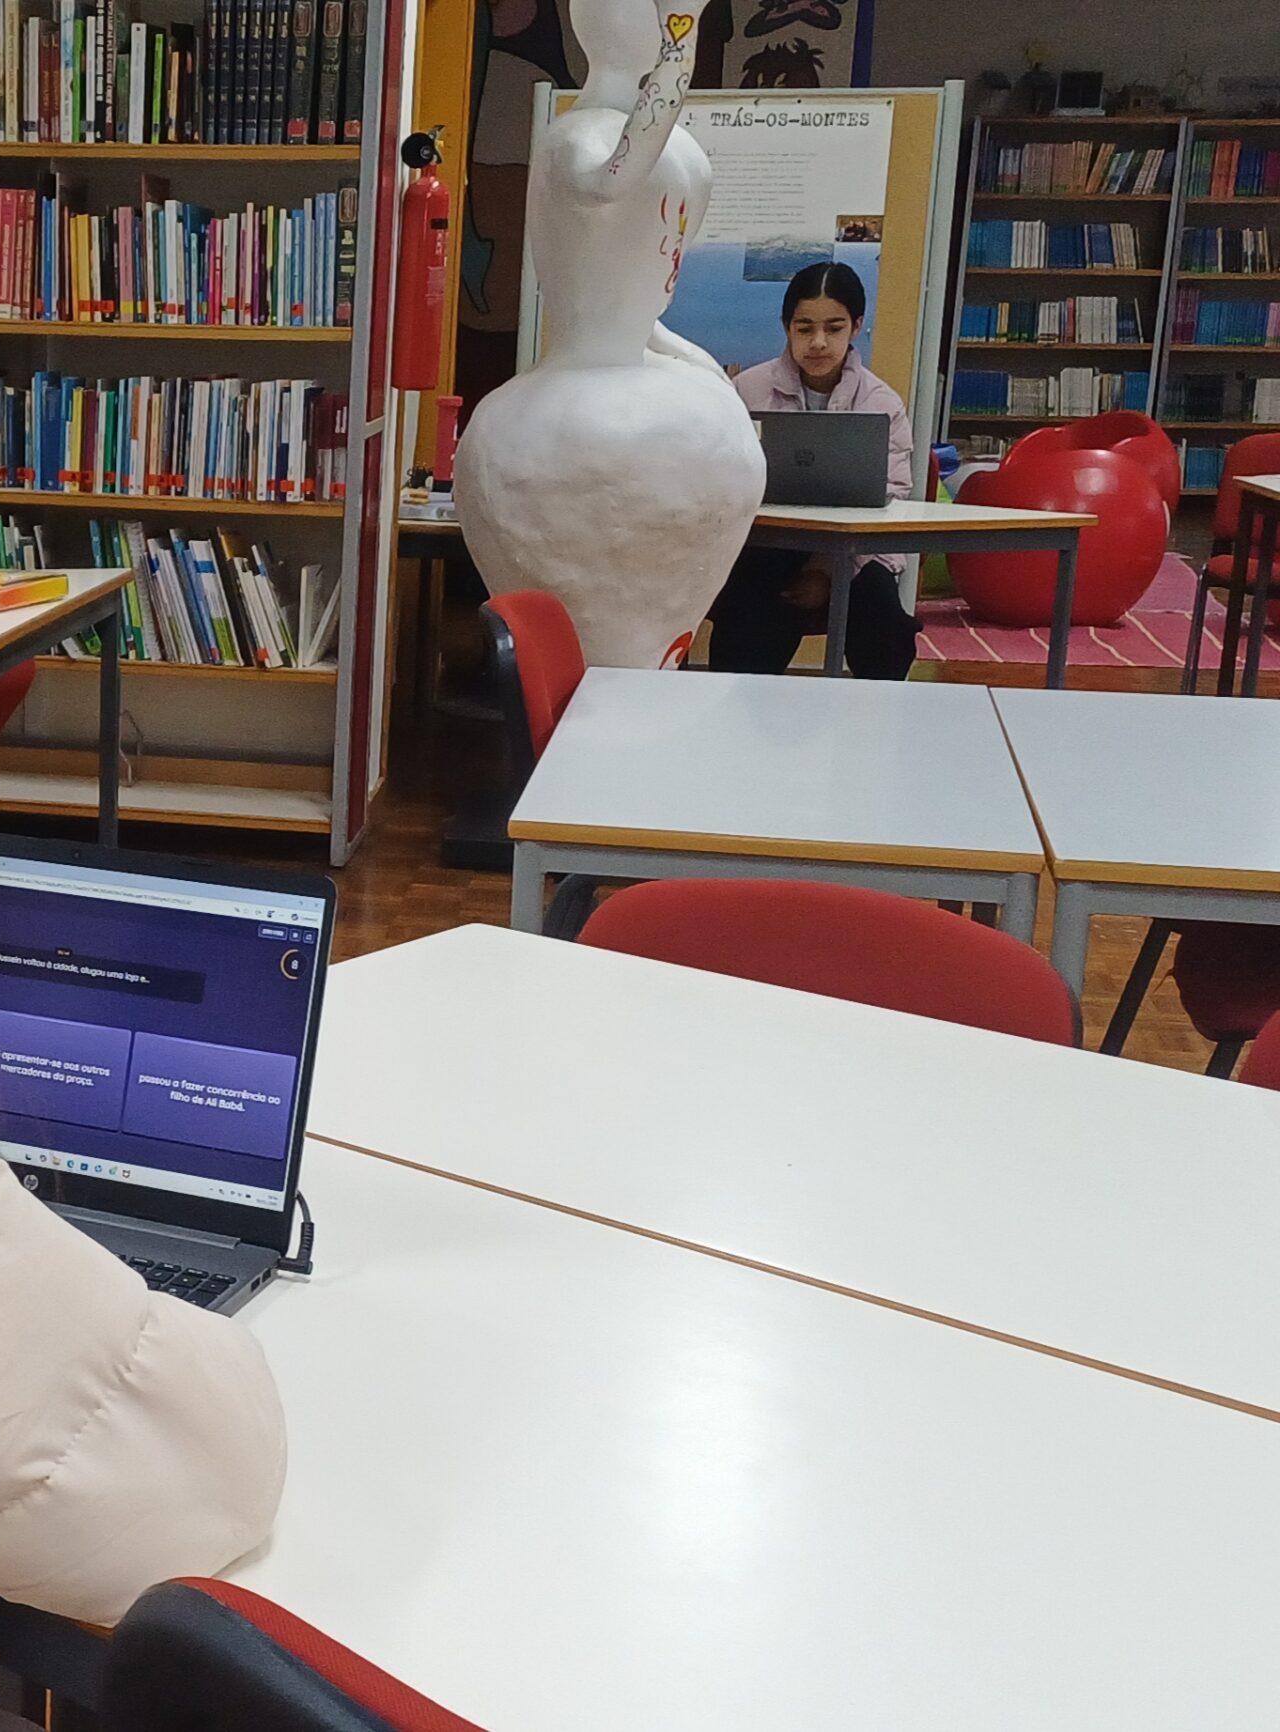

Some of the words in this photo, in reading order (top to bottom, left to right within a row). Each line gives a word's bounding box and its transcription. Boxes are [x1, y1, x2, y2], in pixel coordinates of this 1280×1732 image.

[710, 107, 870, 127] TRÁS-OS-MONTES
[23, 957, 46, 969] voltou
[53, 962, 79, 974] cidade,
[80, 966, 106, 978] alugou
[106, 970, 124, 981] uma
[124, 971, 140, 983] loja
[0, 1063, 52, 1079] mercadores
[1, 1051, 62, 1068] apresentar-se
[63, 1061, 80, 1072] aos
[81, 1063, 111, 1077] outros
[138, 1074, 171, 1087] passou
[172, 1080, 179, 1088] a
[181, 1079, 206, 1092] fazer
[206, 1084, 266, 1103] concorrência
[267, 1095, 281, 1105] ao
[170, 1090, 190, 1103] filho
[191, 1094, 204, 1106] de
[205, 1096, 218, 1108] Ali
